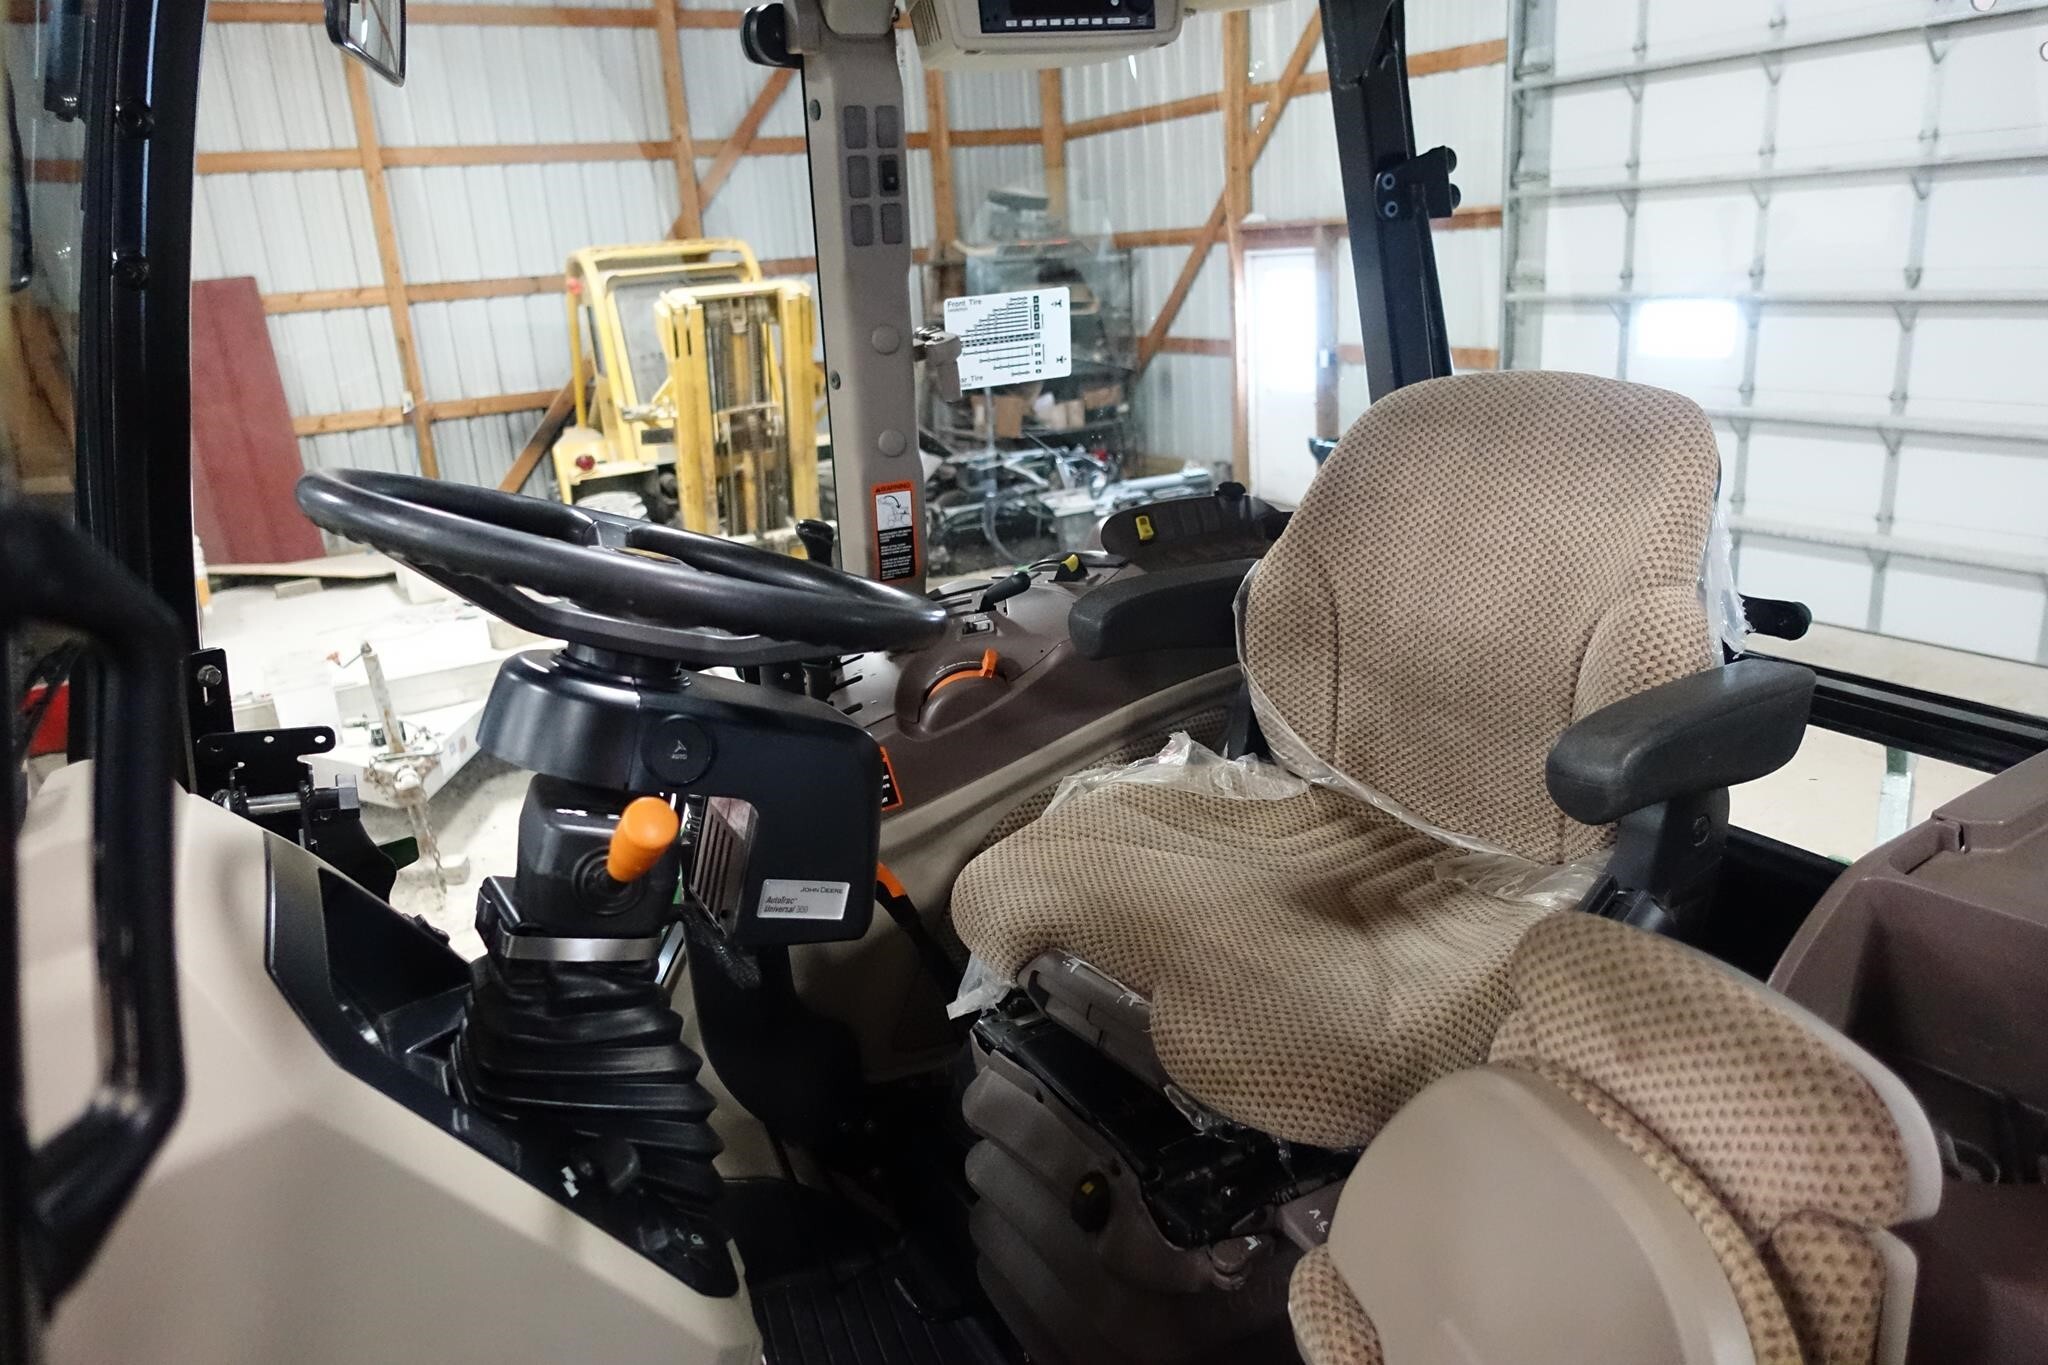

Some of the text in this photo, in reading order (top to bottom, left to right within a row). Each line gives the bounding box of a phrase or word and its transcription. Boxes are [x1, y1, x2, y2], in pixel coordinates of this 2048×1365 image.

[947, 299, 966, 307] Front
[820, 886, 844, 894] DEERE
[764, 905, 795, 913] Universal
